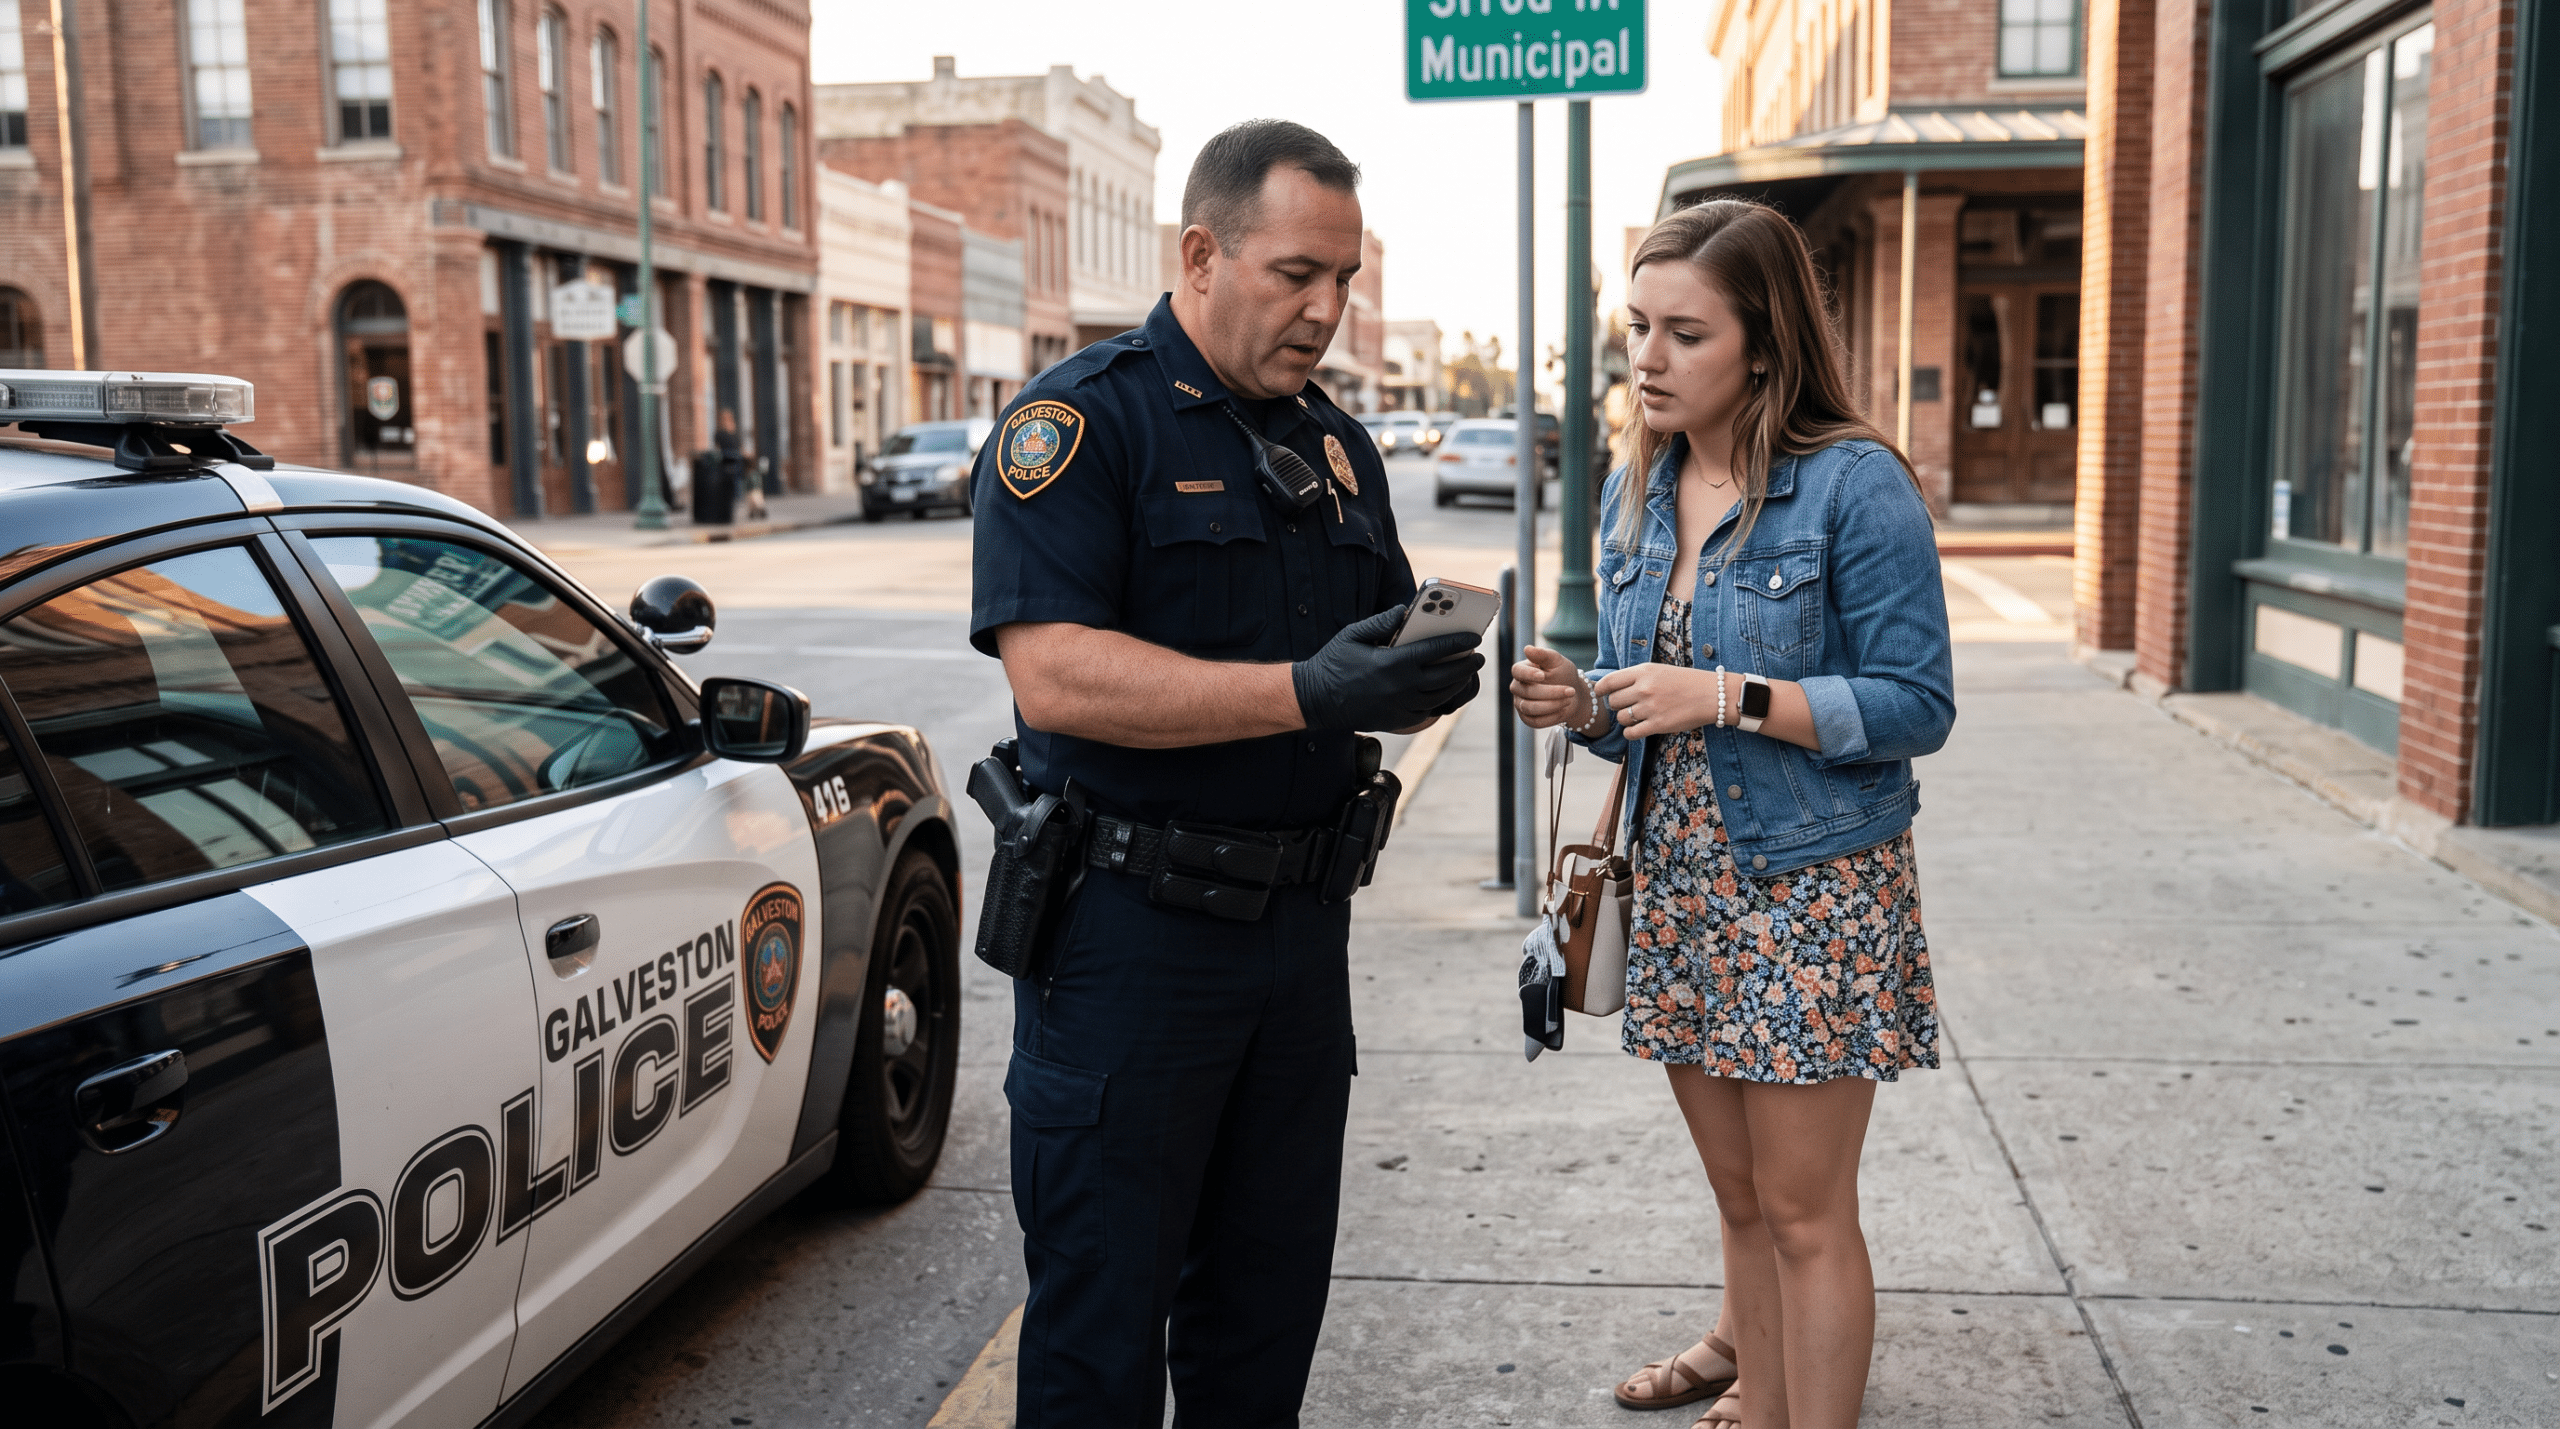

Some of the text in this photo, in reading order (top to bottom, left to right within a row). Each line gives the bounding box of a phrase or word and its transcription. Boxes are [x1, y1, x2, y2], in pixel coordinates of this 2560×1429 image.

[1420, 26, 1630, 89] Municipal
[1007, 465, 1051, 481] POLICE
[812, 775, 852, 824] 416
[544, 919, 736, 1063] GALVESTON
[257, 971, 736, 1417] POLICE
